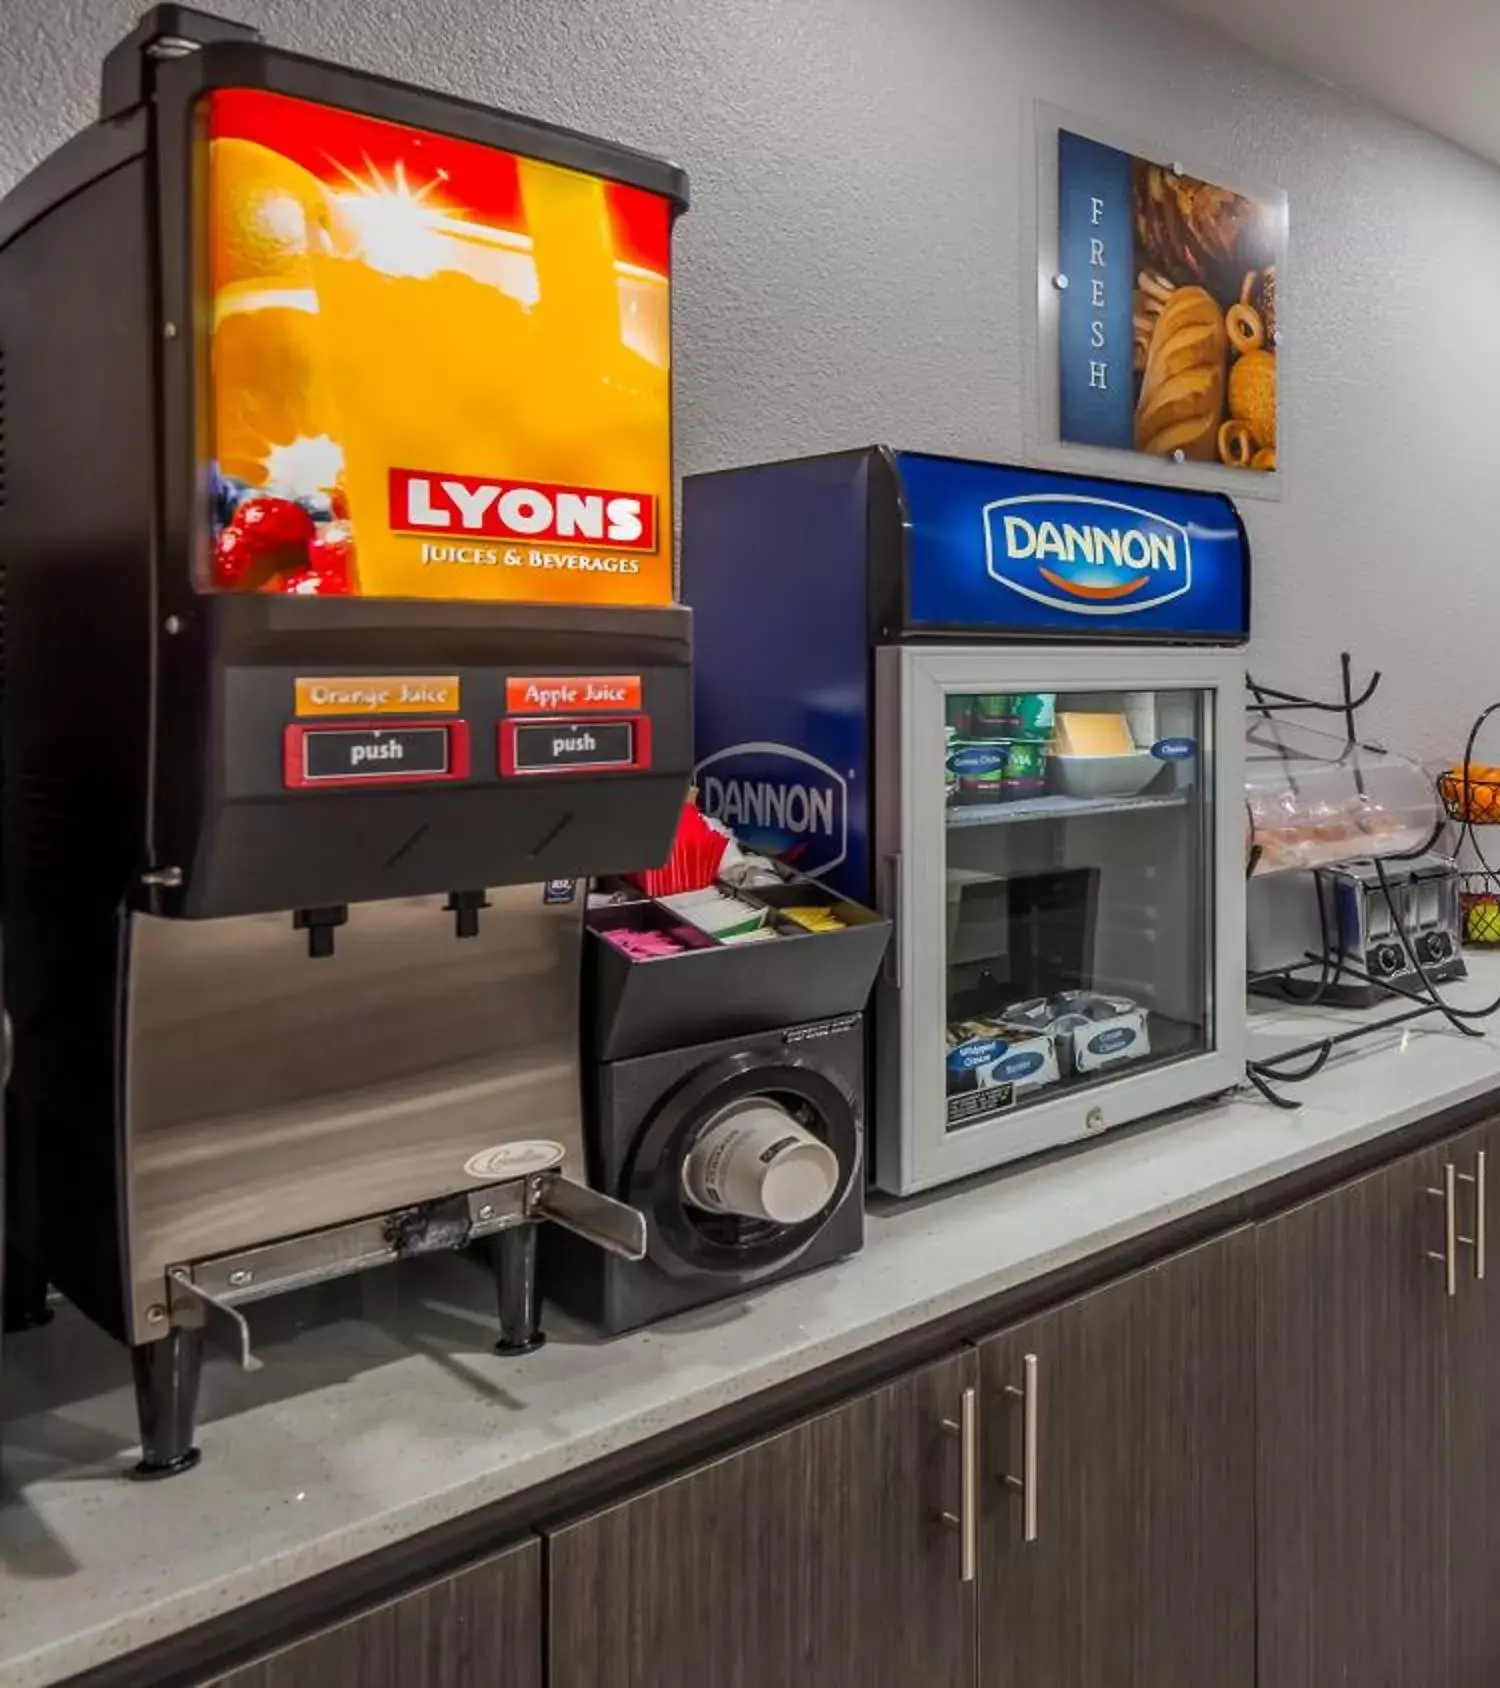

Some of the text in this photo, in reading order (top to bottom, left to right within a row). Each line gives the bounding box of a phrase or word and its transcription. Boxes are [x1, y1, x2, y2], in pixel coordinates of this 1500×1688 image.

[1088, 196, 1108, 390] FRESH
[407, 477, 644, 542] LYONS
[1002, 514, 1178, 572] DANNON
[502, 548, 523, 567] &
[310, 683, 449, 710] Orange Juice
[524, 683, 627, 709] Apple Juice
[350, 738, 404, 766] push
[551, 732, 597, 757] push
[704, 776, 834, 836] DANNON
